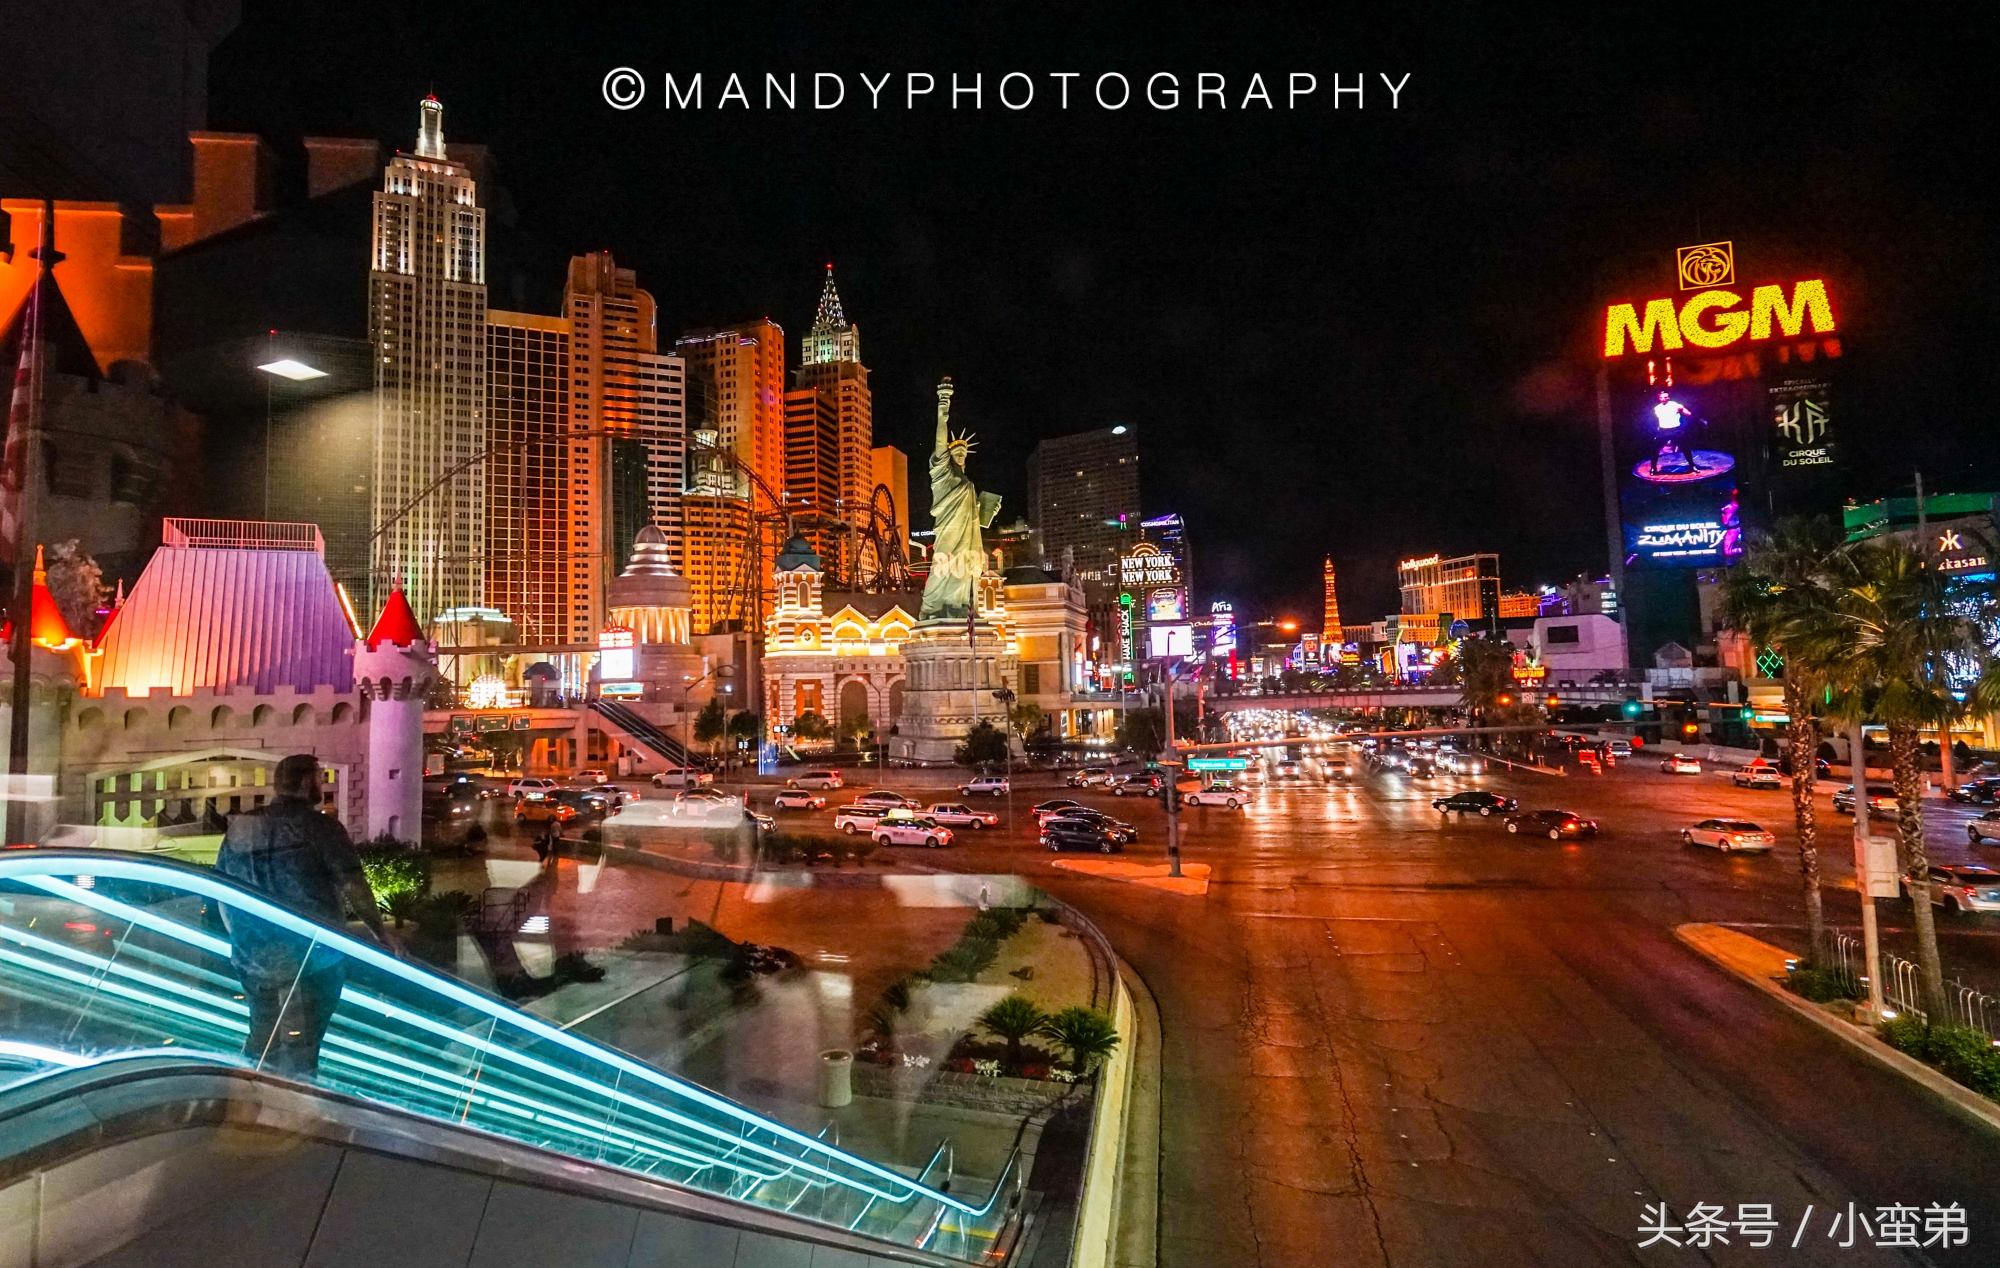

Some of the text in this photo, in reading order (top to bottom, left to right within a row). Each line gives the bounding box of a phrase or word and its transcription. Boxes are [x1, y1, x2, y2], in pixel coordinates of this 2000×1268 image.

[1604, 278, 1836, 357] MGM
[1788, 448, 1827, 458] CIRQUE
[1783, 456, 1834, 467] DU SOLEIL
[1644, 525, 1676, 533] CIRQUE
[1690, 522, 1720, 530] SOLEIL
[1638, 528, 1728, 548] ZUMANITY
[1121, 555, 1173, 570] NEW YORK
[1401, 553, 1439, 571] hollywood
[1121, 569, 1173, 583] NEW YORK
[1211, 601, 1233, 613] Aria
[1120, 610, 1130, 636] SHACK
